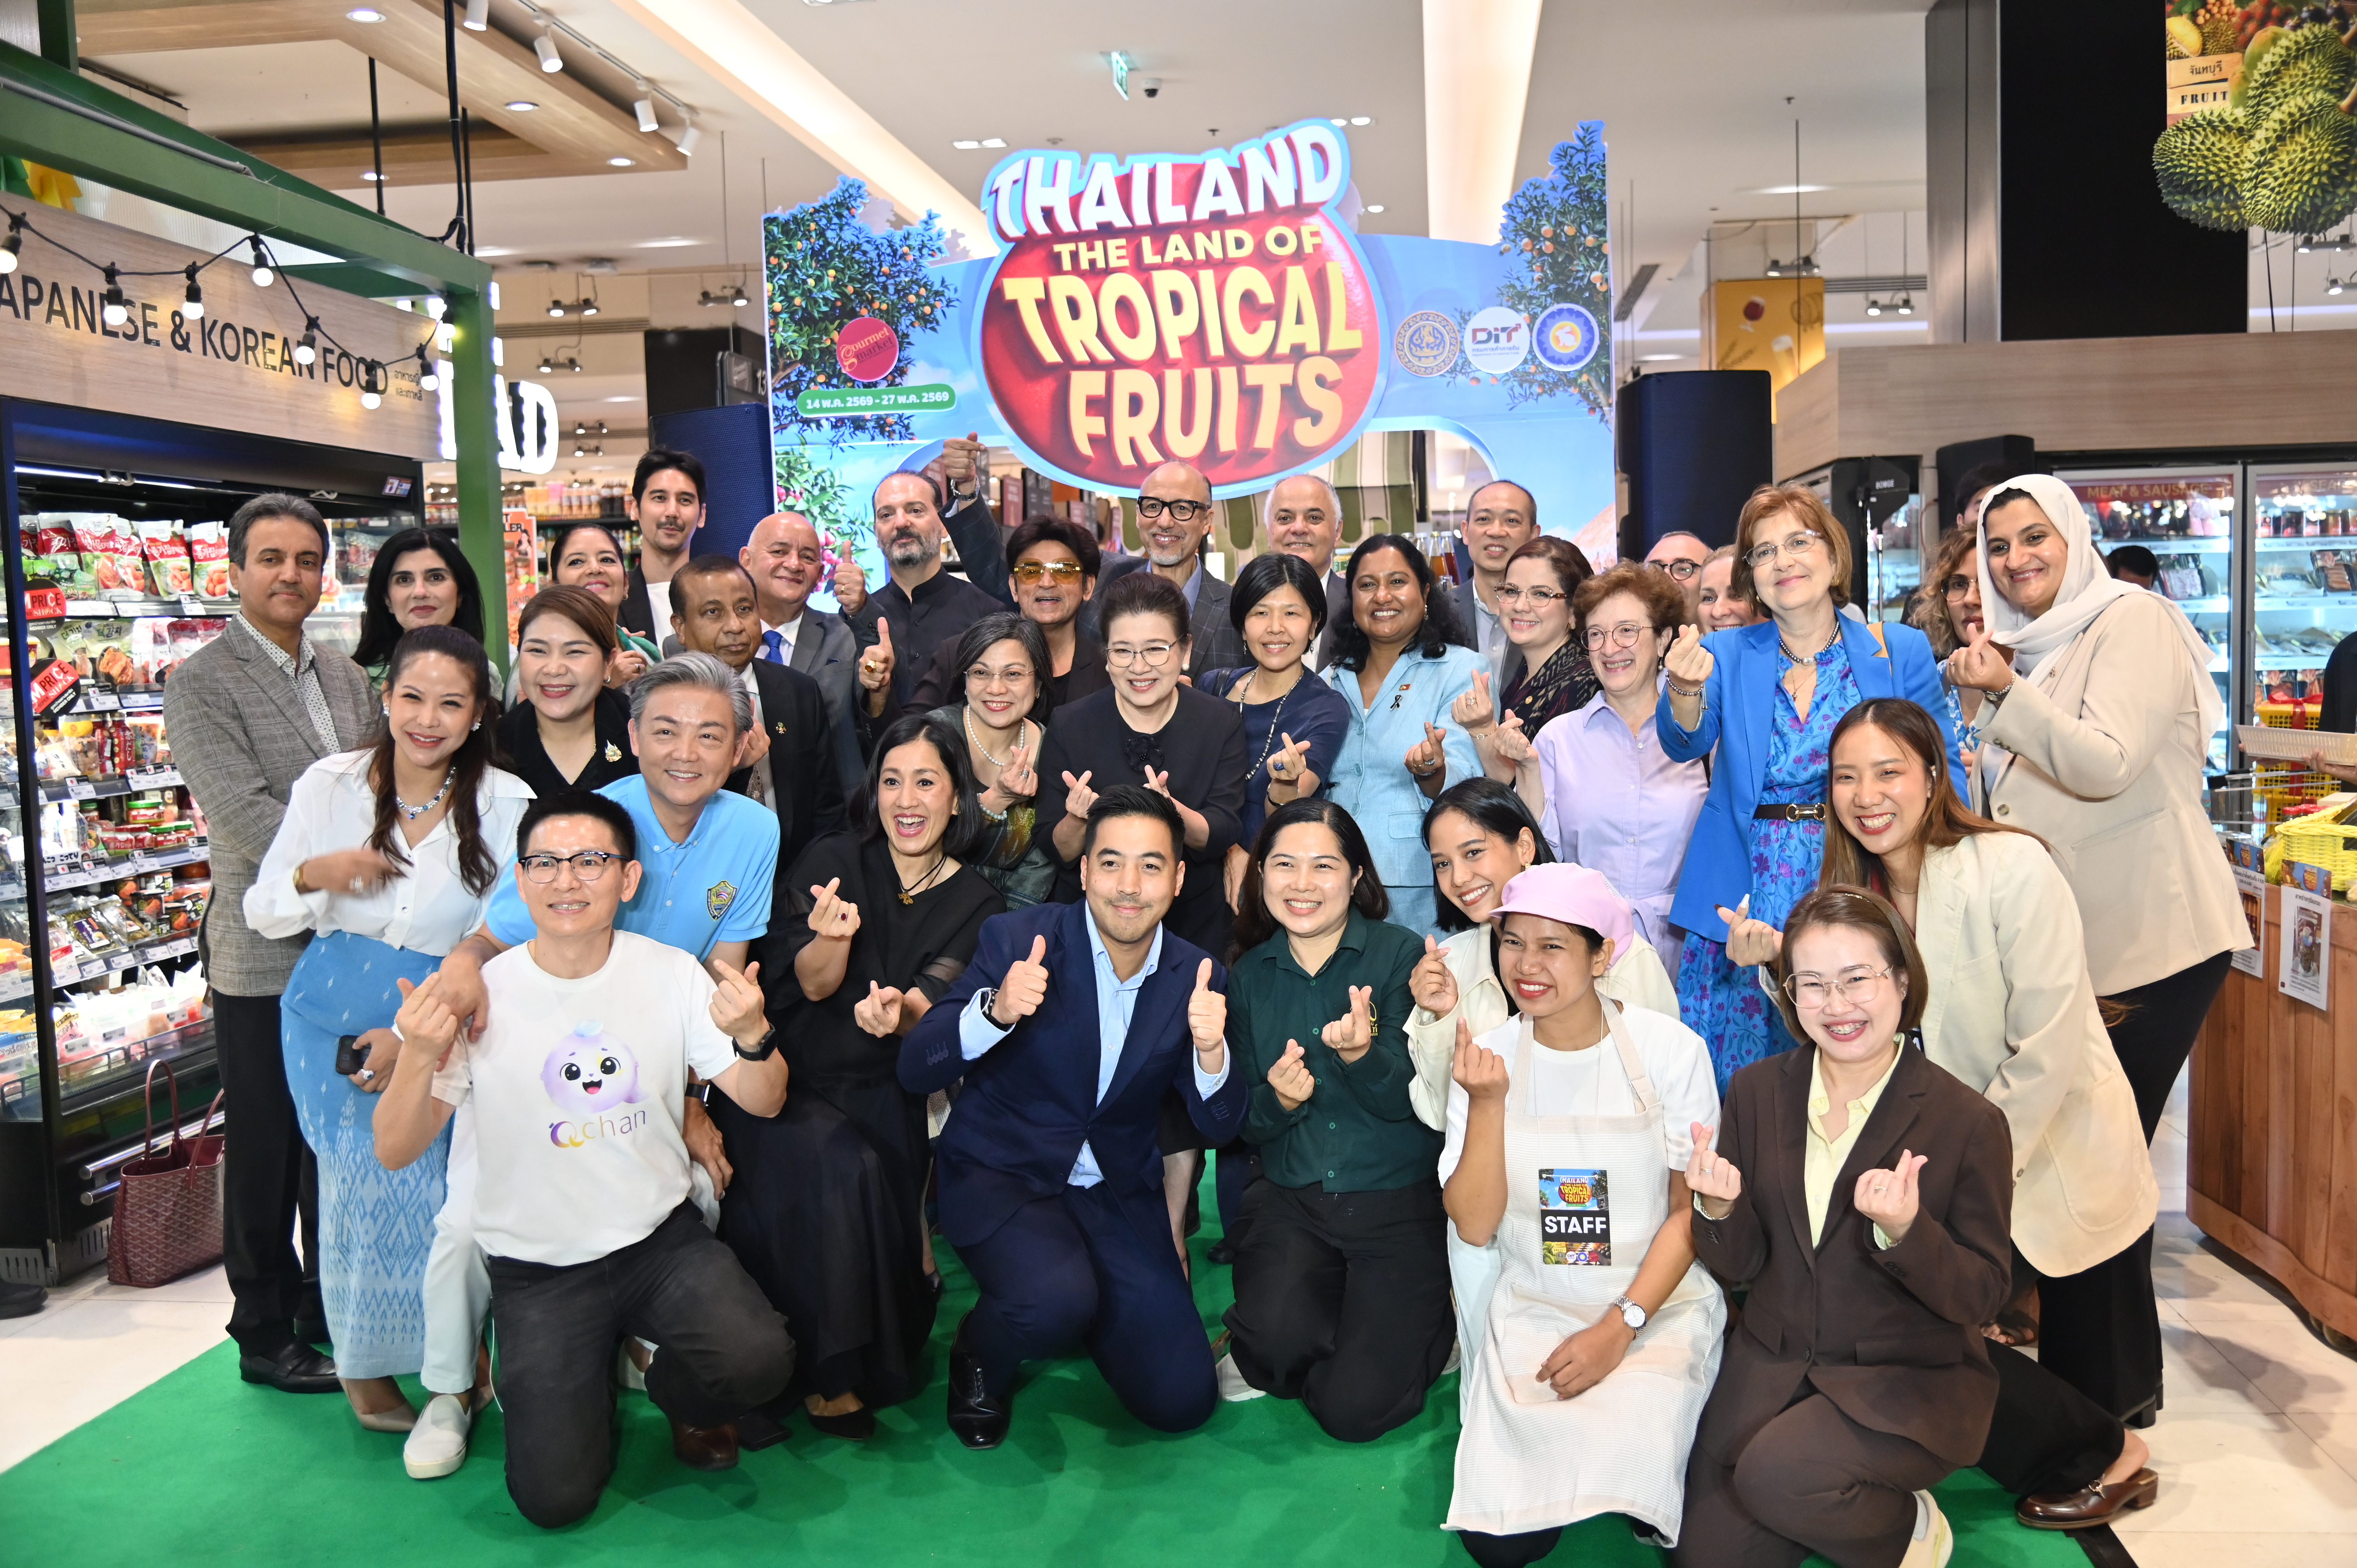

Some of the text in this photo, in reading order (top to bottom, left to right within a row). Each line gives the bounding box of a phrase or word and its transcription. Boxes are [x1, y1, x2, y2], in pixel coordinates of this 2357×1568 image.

[2190, 60, 2223, 76] จันทบุรี
[2181, 91, 2228, 105] FRUIT
[991, 125, 1342, 238] THAILAND
[1053, 224, 1322, 272] THE LAND OF
[1002, 261, 1362, 366] TROPICAL
[0, 274, 388, 396] APANESE & KOREAN FOOD
[856, 336, 893, 361] market
[806, 399, 820, 409] 14
[846, 396, 873, 407] 2569
[882, 395, 895, 405] 27
[922, 391, 949, 403] 2569
[1067, 355, 1343, 468] FRUITS
[2087, 485, 2126, 499] MEAT
[549, 1110, 646, 1148] Qchan
[1560, 1185, 1590, 1195] TROPICAL
[1565, 1194, 1588, 1202] FRUITS
[1544, 1216, 1606, 1234] STAFF
